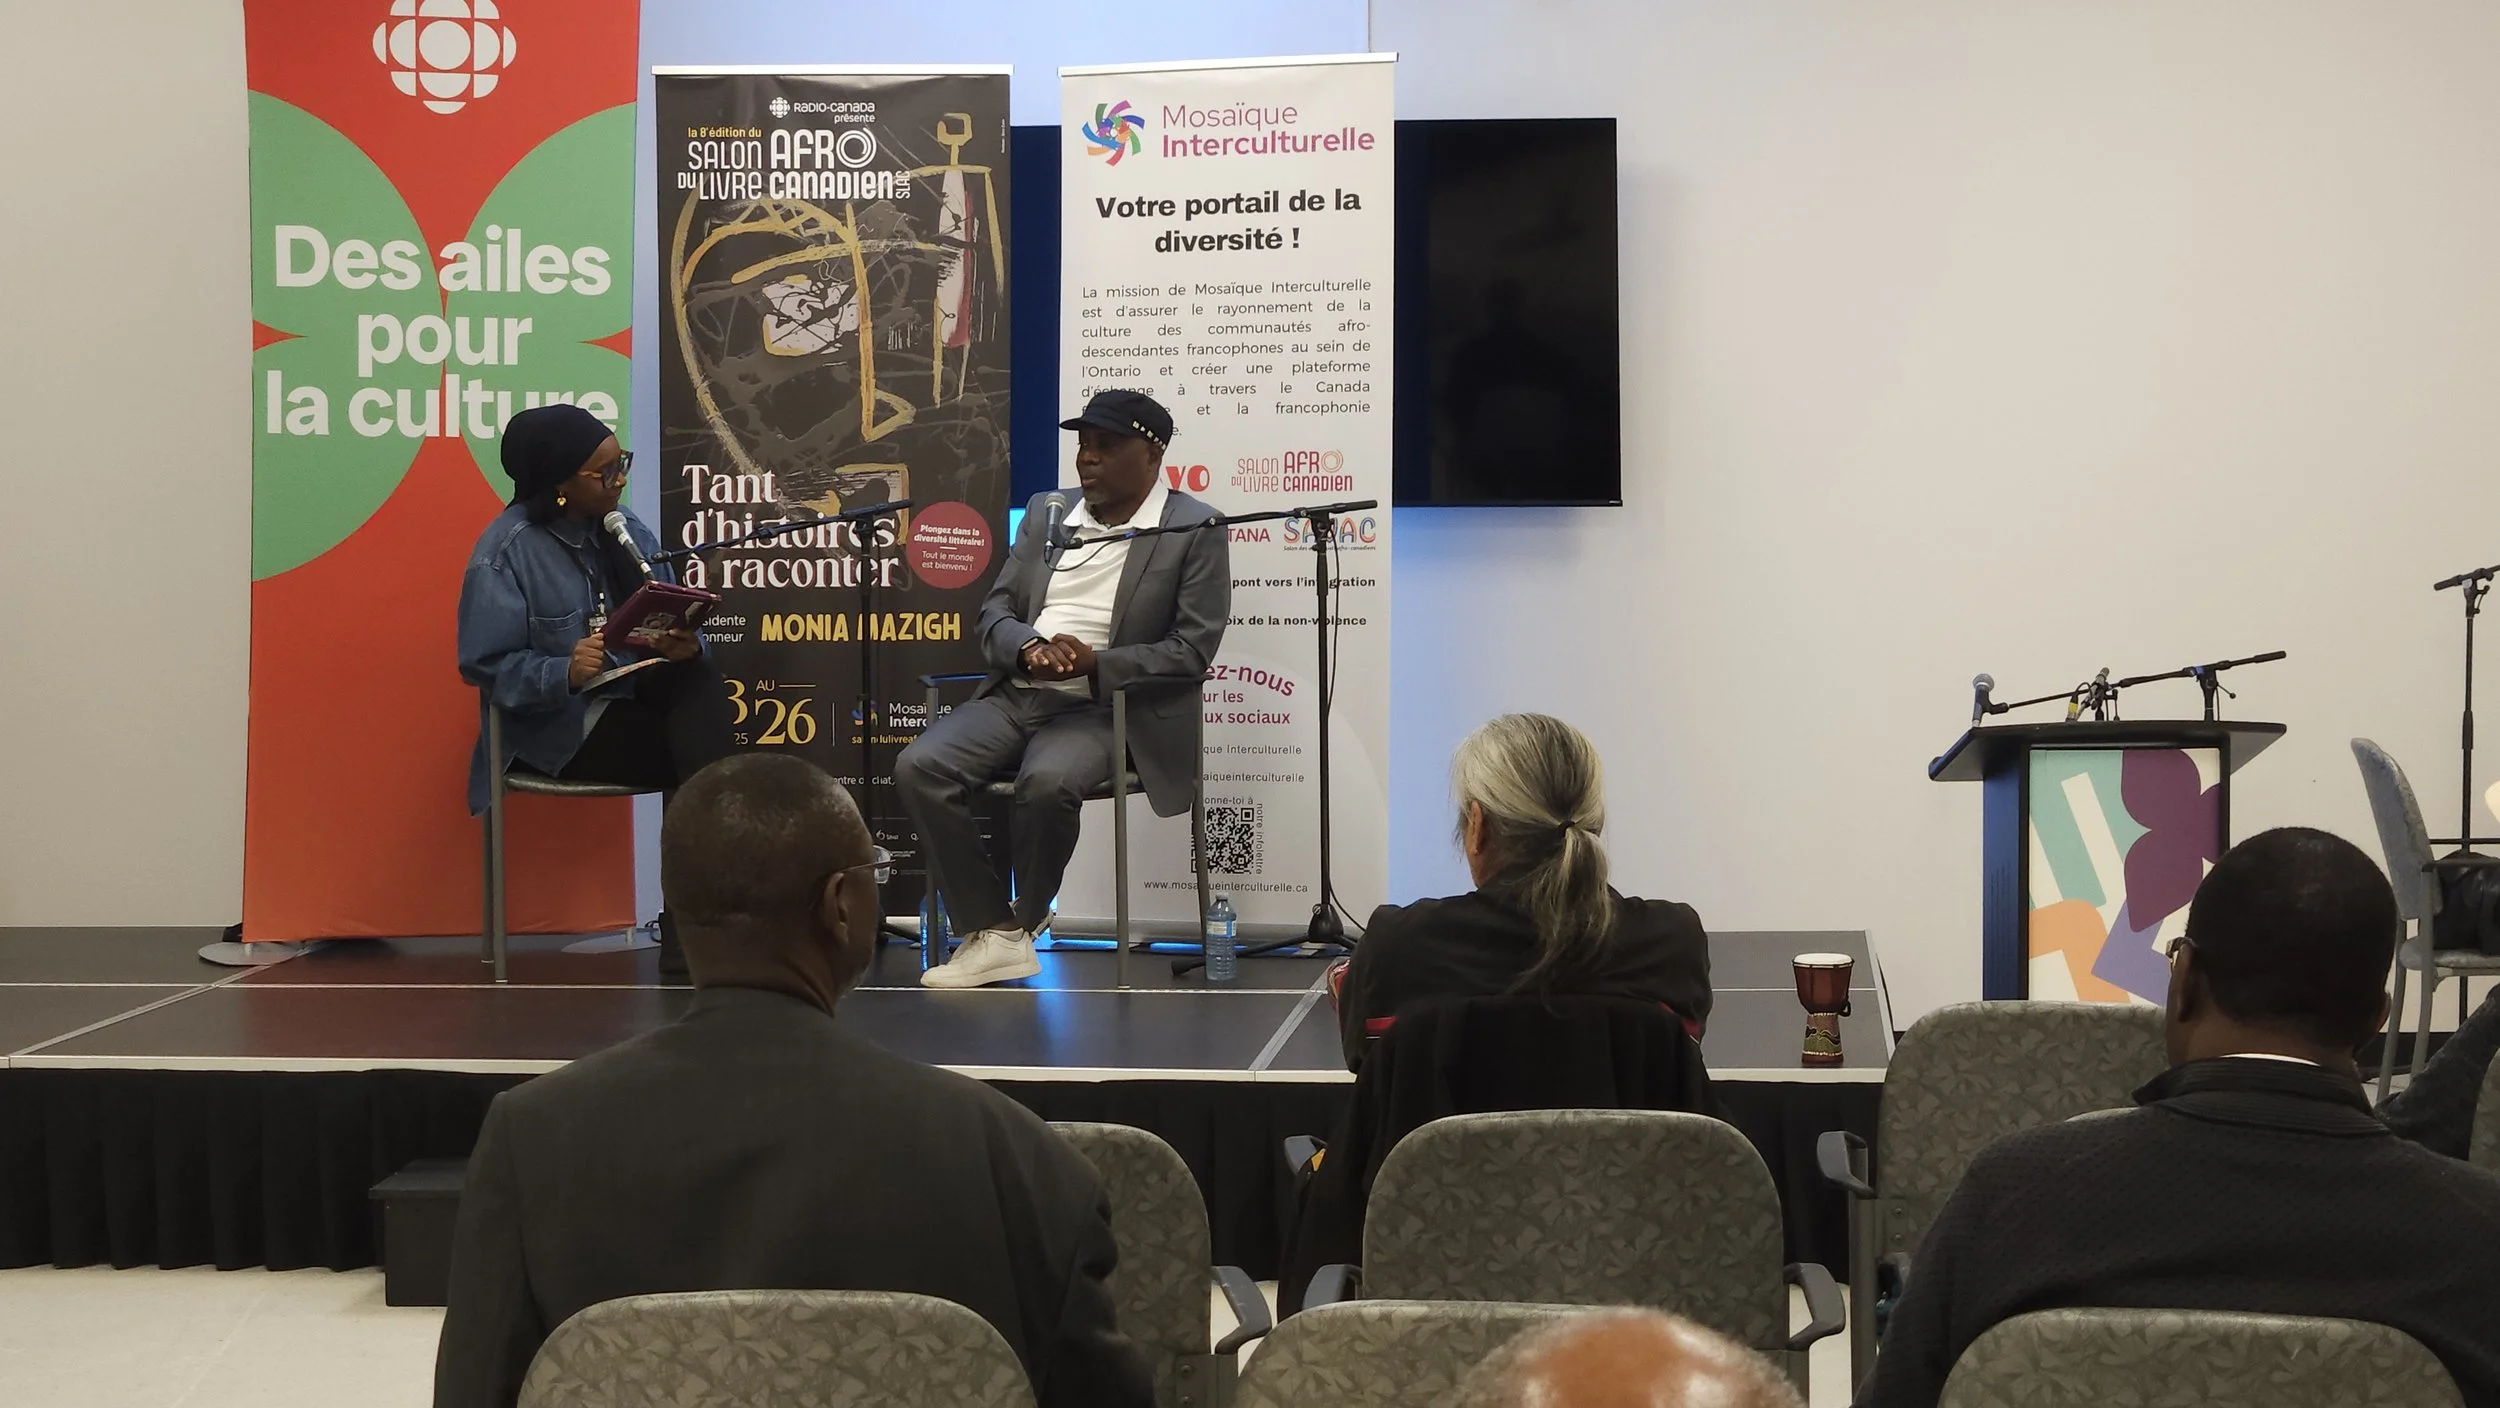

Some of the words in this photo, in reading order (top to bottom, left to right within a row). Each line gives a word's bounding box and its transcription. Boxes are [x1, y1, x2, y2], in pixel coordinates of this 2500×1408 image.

[834, 114, 875, 124] présente
[1163, 102, 1297, 131] Mosaïque
[688, 127, 697, 137] la
[749, 127, 761, 137] du
[688, 141, 762, 170] SALON
[770, 127, 876, 169] AFRO
[1163, 127, 1375, 158] Interculturelle
[678, 172, 696, 189] DU
[700, 172, 762, 200] LIVRE
[770, 171, 893, 200] CANADIEN
[1096, 196, 1175, 218] Votre
[1186, 191, 1279, 222] portail
[1289, 190, 1325, 212] de
[1335, 188, 1361, 211] la
[1155, 226, 1283, 253] diversité
[1292, 228, 1300, 249] !
[275, 225, 422, 290] Des
[439, 224, 612, 296] ailes
[1082, 287, 1097, 299] La
[1106, 285, 1160, 298] mission
[1168, 284, 1186, 296] de
[1195, 282, 1263, 297] Mosaïque
[1271, 279, 1371, 294] Interculturelle
[1082, 308, 1102, 318] est
[1116, 305, 1178, 318] d'assurer
[1192, 304, 1203, 316] le
[1217, 302, 1313, 317] rayonnement
[1327, 300, 1345, 312] de
[1359, 299, 1370, 312] la
[1082, 325, 1131, 338] culture
[1157, 324, 1182, 337] des
[1208, 321, 1312, 335] communautés
[1338, 320, 1370, 332] afro-
[358, 314, 532, 378] pour
[1082, 345, 1179, 358] descendantes
[1187, 342, 1283, 357] francophones
[1291, 344, 1308, 353] au
[1316, 341, 1345, 353] sein
[1352, 340, 1370, 352] de
[1082, 366, 1141, 378] l'Ontario
[1159, 365, 1173, 376] et
[1192, 363, 1227, 375] créer
[1246, 364, 1273, 374] une
[1292, 360, 1370, 375] plateforme
[1177, 384, 1185, 396] à
[1209, 383, 1257, 395] travers
[1280, 382, 1292, 394] le
[1316, 381, 1370, 393] Canada
[267, 370, 329, 435] la
[1197, 404, 1211, 415] et
[1237, 402, 1249, 415] la
[1275, 401, 1370, 416] francophonie
[1237, 458, 1279, 475] SALON
[1284, 449, 1344, 474] AFRO
[682, 465, 778, 504] Tant
[1165, 465, 1210, 492] VO
[1231, 476, 1242, 486] DU
[1244, 476, 1279, 492] LIVRE
[1283, 475, 1353, 492] CANADIEN
[914, 534, 948, 544] diversité
[920, 524, 951, 534] Plongez
[953, 527, 971, 536] dans
[973, 528, 980, 536] la
[1227, 528, 1271, 543] TANA
[922, 551, 938, 559] Tout
[940, 552, 946, 560] le
[948, 554, 974, 562] monde
[683, 554, 707, 588] à
[1233, 577, 1261, 589] pont
[1265, 579, 1292, 587] vers
[1297, 577, 1375, 589] l'ingration
[702, 614, 746, 626] sidente
[761, 613, 849, 642] MONIA
[1226, 616, 1244, 625] oix
[1249, 616, 1264, 625] de
[1269, 616, 1280, 625] la
[1284, 616, 1367, 625] non-volence
[702, 633, 744, 642] onneur
[1205, 665, 1295, 697] ez-nous
[724, 679, 748, 725] 3
[756, 680, 775, 691] AU
[1203, 692, 1218, 703] ur
[1223, 690, 1244, 703] les
[755, 698, 816, 744] 26
[1205, 712, 1223, 723] ux
[1228, 710, 1290, 724] sociaux
[734, 733, 749, 745] 25
[1203, 745, 1222, 755] que
[1227, 745, 1302, 755] Interculturelle
[1203, 772, 1304, 783] aiqueinterculturelle
[1256, 832, 1264, 874] infolettre
[1144, 881, 1308, 893] www.mosaueinterculturelle.ca
